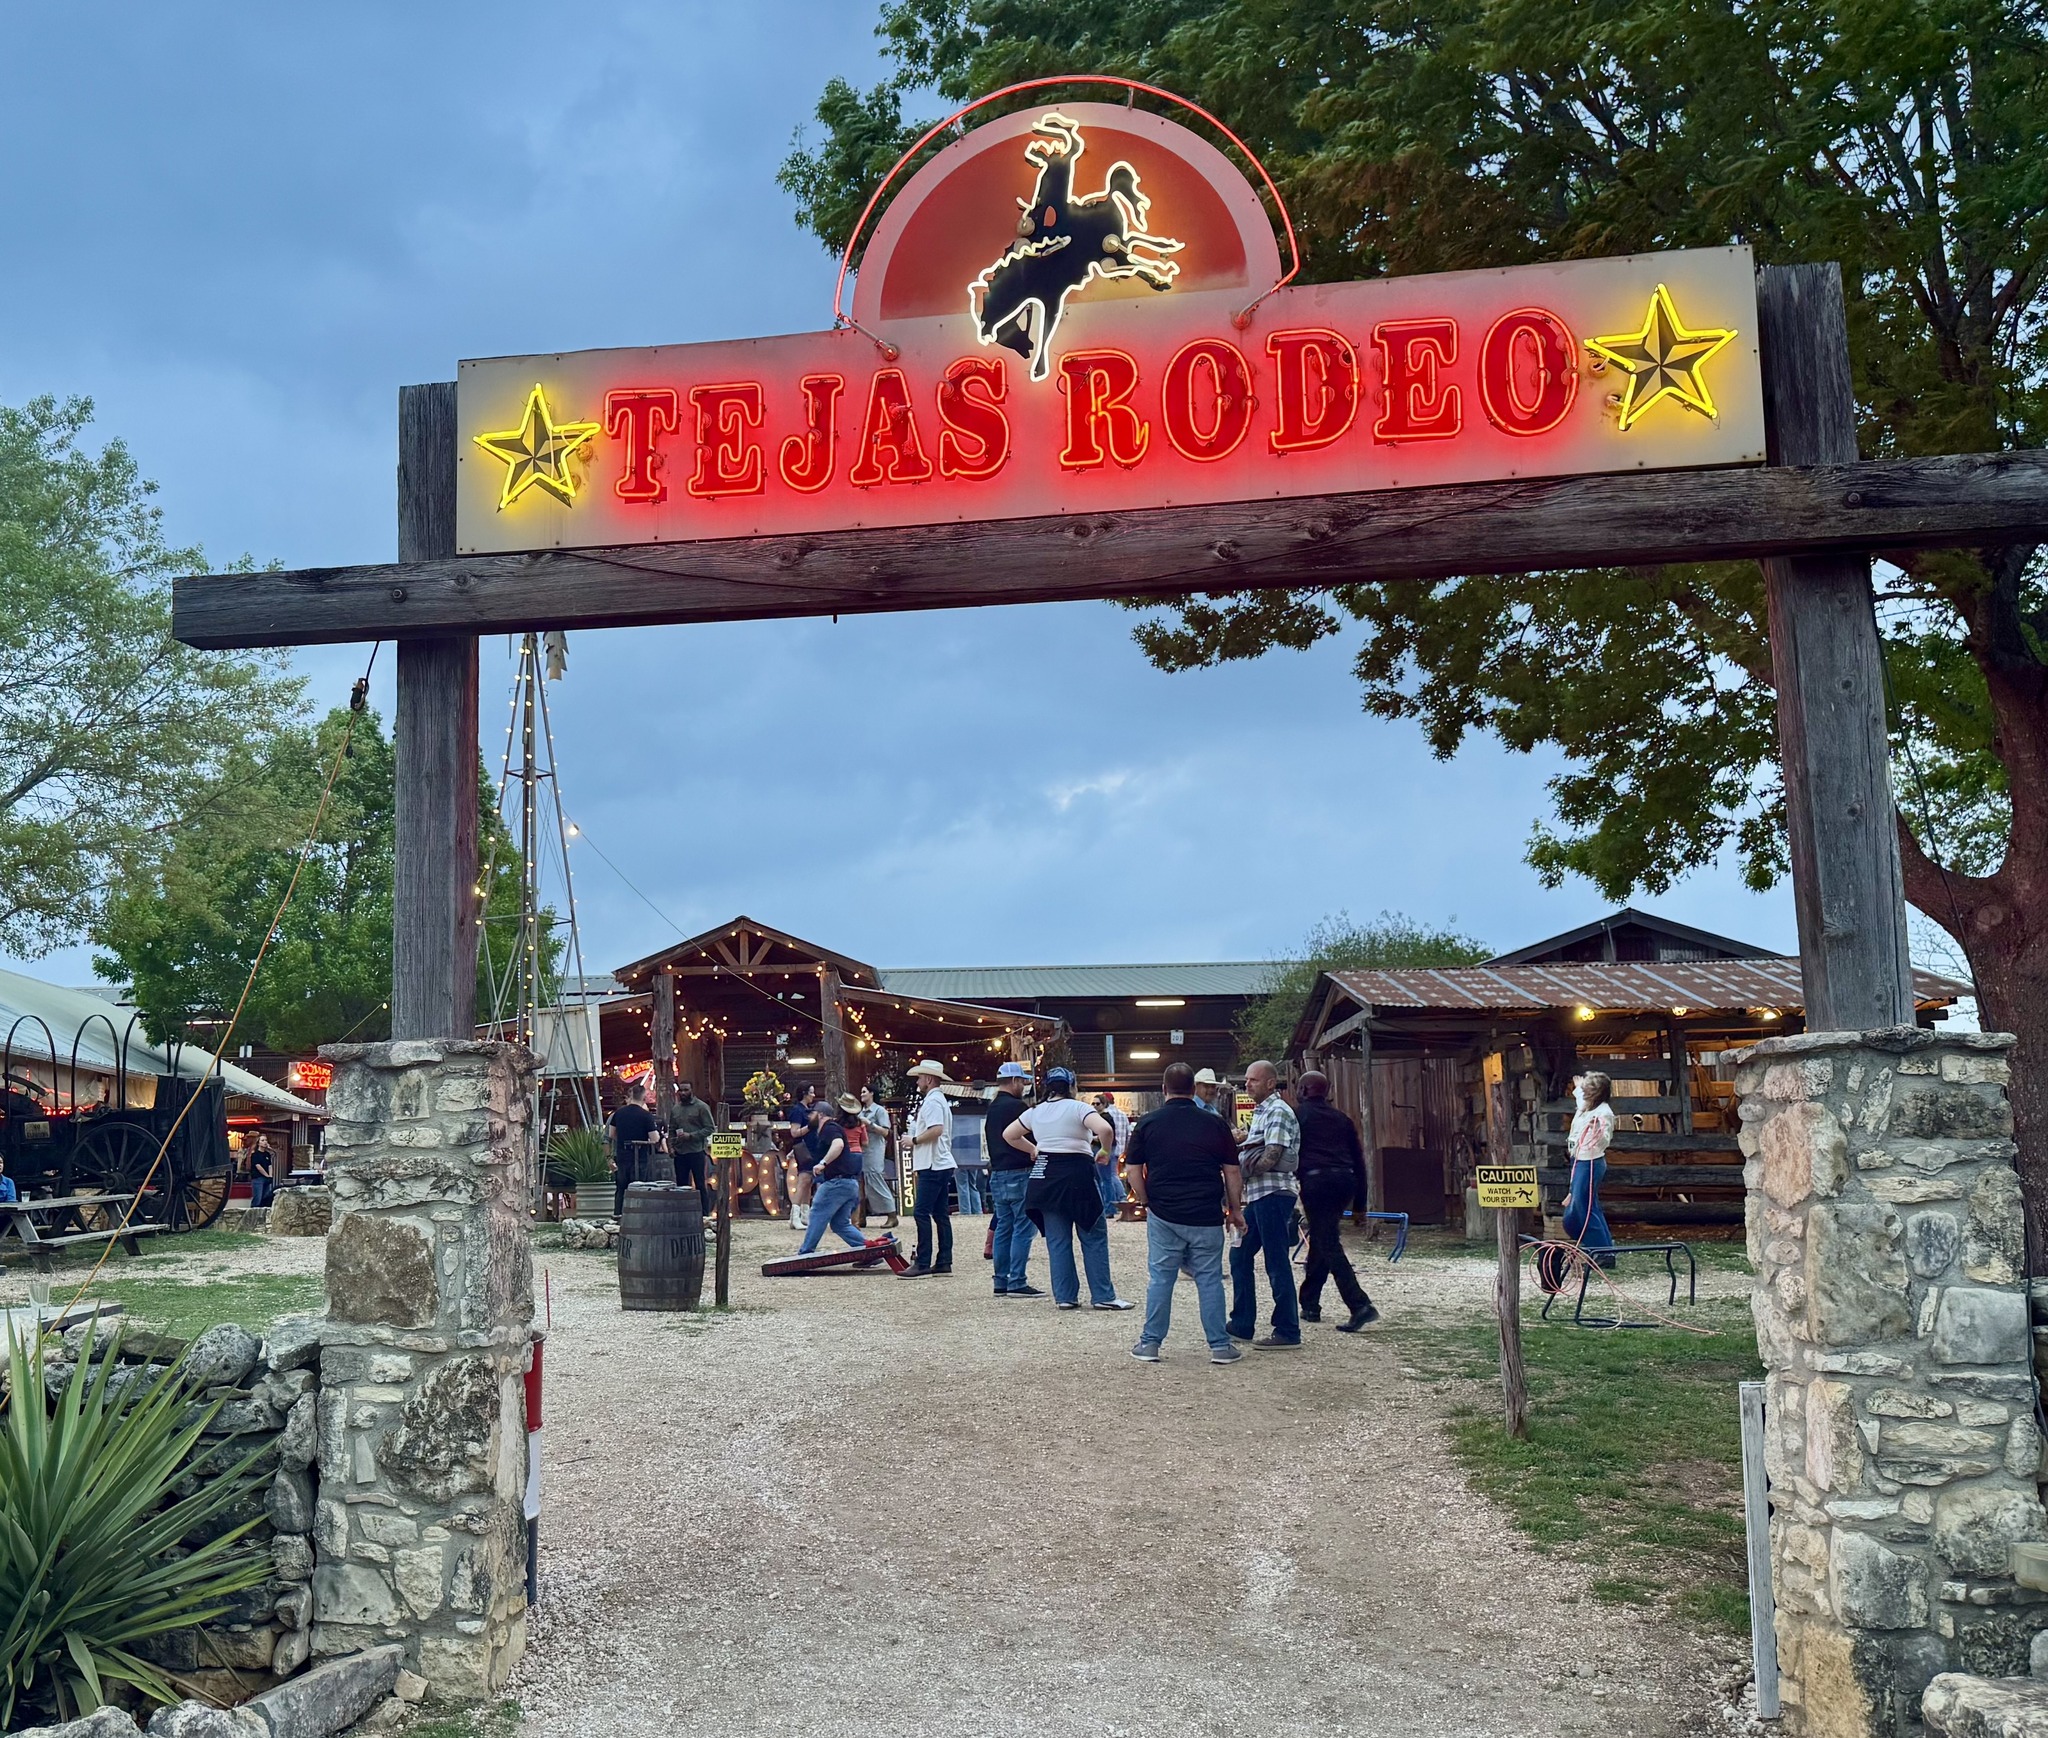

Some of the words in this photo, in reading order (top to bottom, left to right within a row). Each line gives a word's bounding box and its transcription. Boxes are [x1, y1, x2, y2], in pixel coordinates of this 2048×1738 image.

[604, 355, 1011, 505] TEJAS
[1057, 305, 1581, 473] RODEO
[713, 1135, 741, 1143] CAUTION
[902, 1150, 915, 1208] CARTER
[1480, 1170, 1534, 1182] CAUTION
